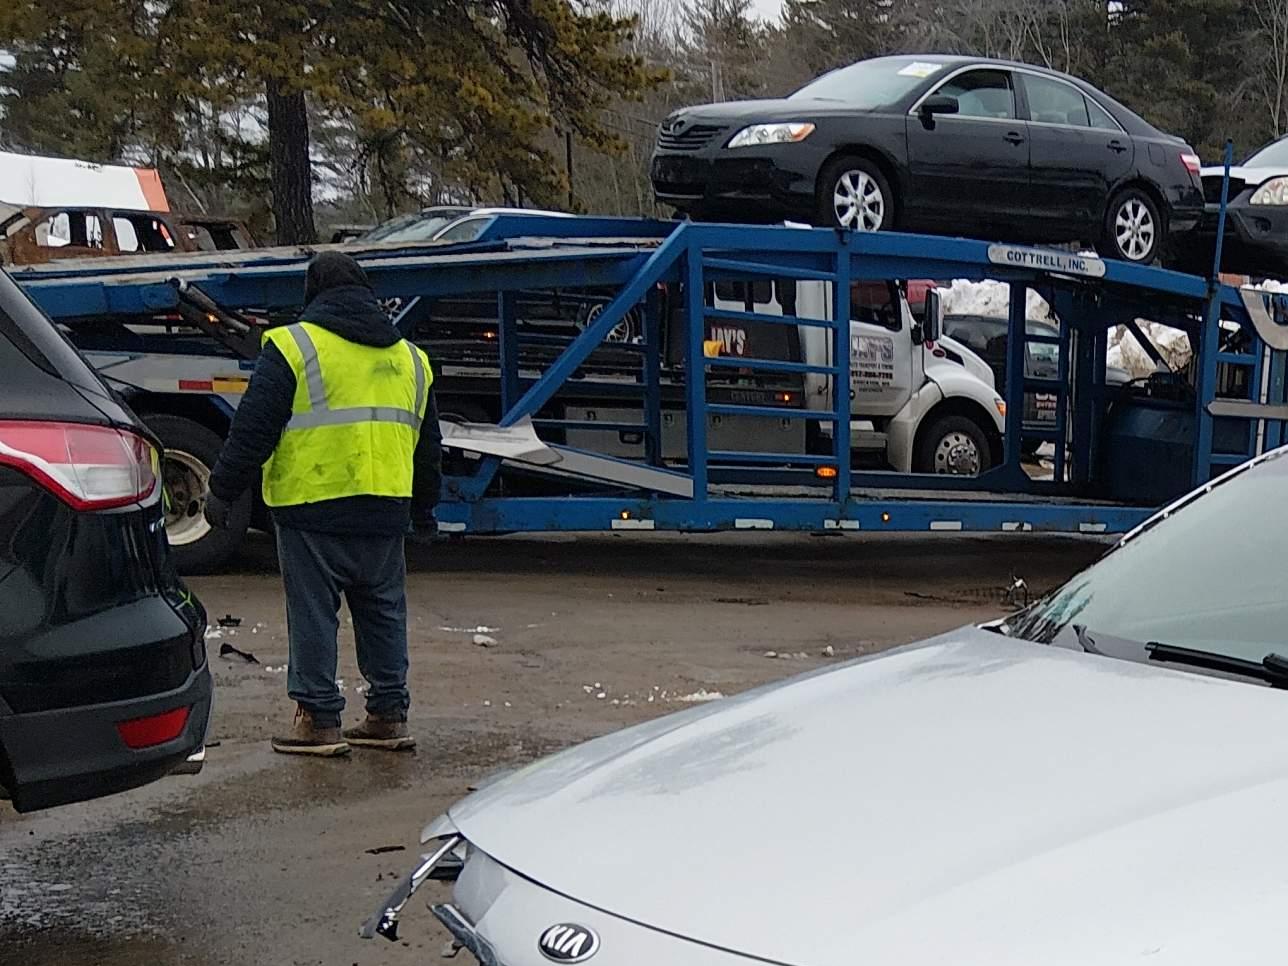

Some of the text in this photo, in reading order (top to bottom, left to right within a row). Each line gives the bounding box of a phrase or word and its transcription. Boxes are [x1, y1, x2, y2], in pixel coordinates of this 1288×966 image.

[1007, 250, 1089, 273] COTTRELL, INC.
[541, 925, 587, 957] KIA
